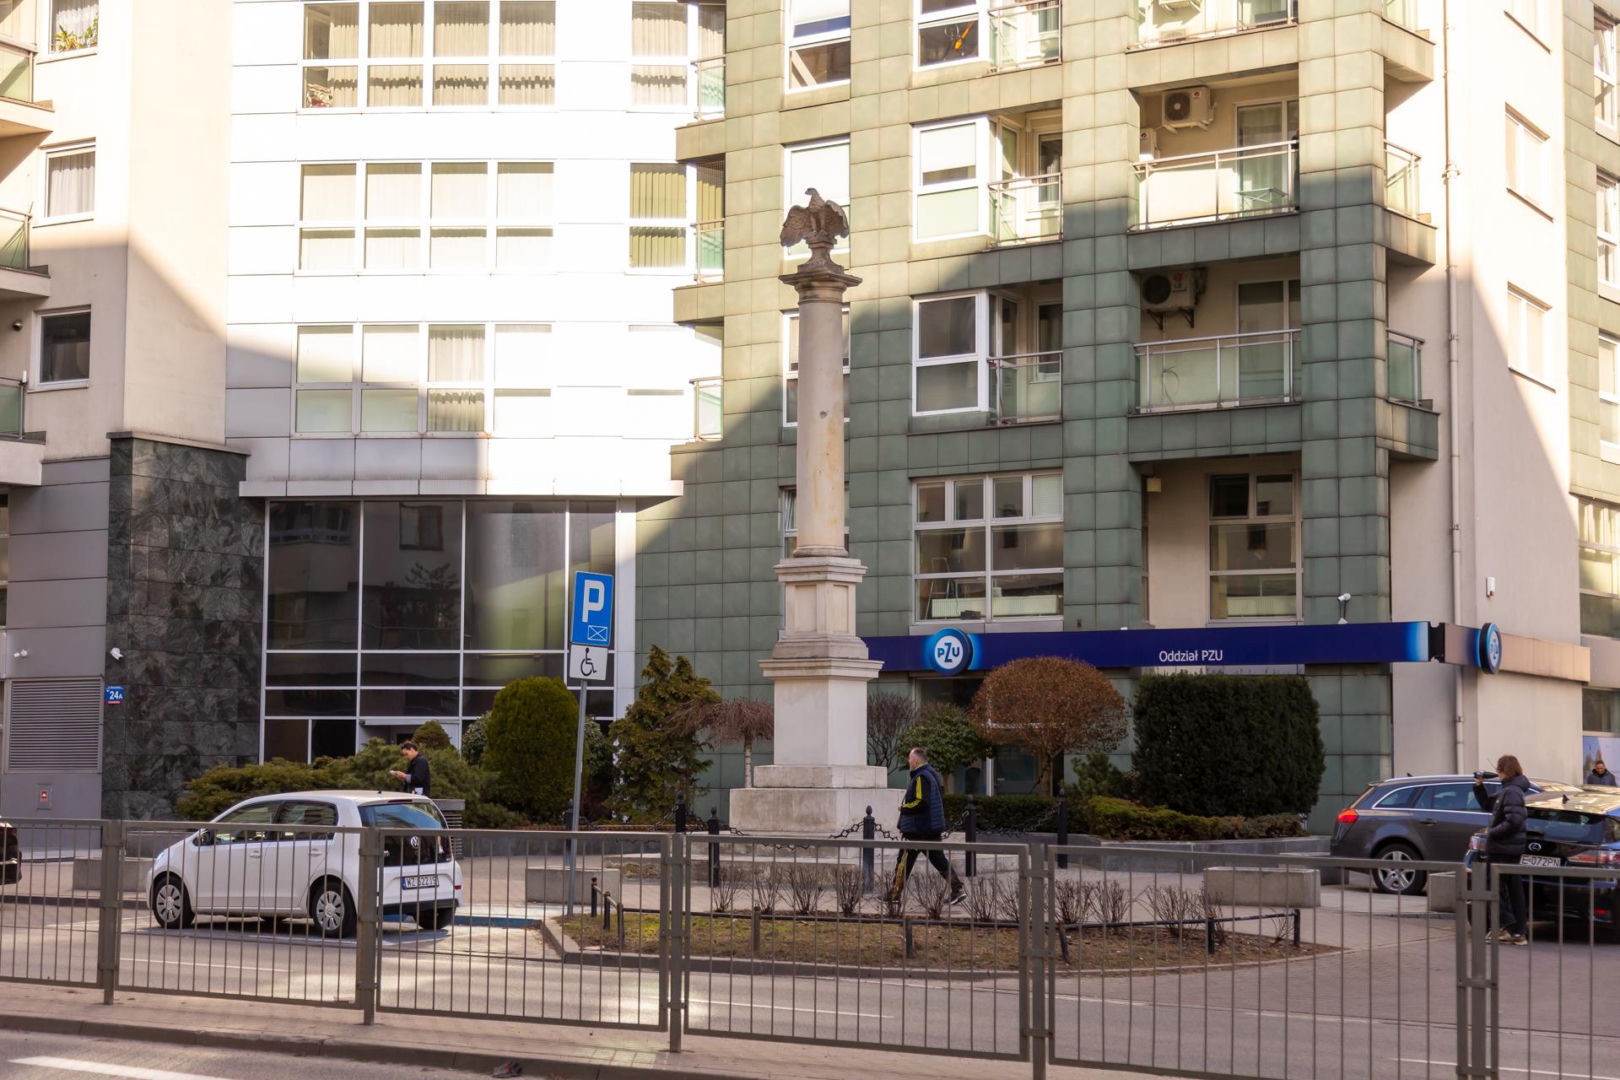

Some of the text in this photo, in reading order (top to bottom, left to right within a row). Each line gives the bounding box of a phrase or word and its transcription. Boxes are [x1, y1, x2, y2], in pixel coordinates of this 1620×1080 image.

[582, 579, 605, 623] P
[937, 642, 960, 663] PZU
[1159, 649, 1223, 662] Oddział PZU
[109, 690, 124, 700] 24A
